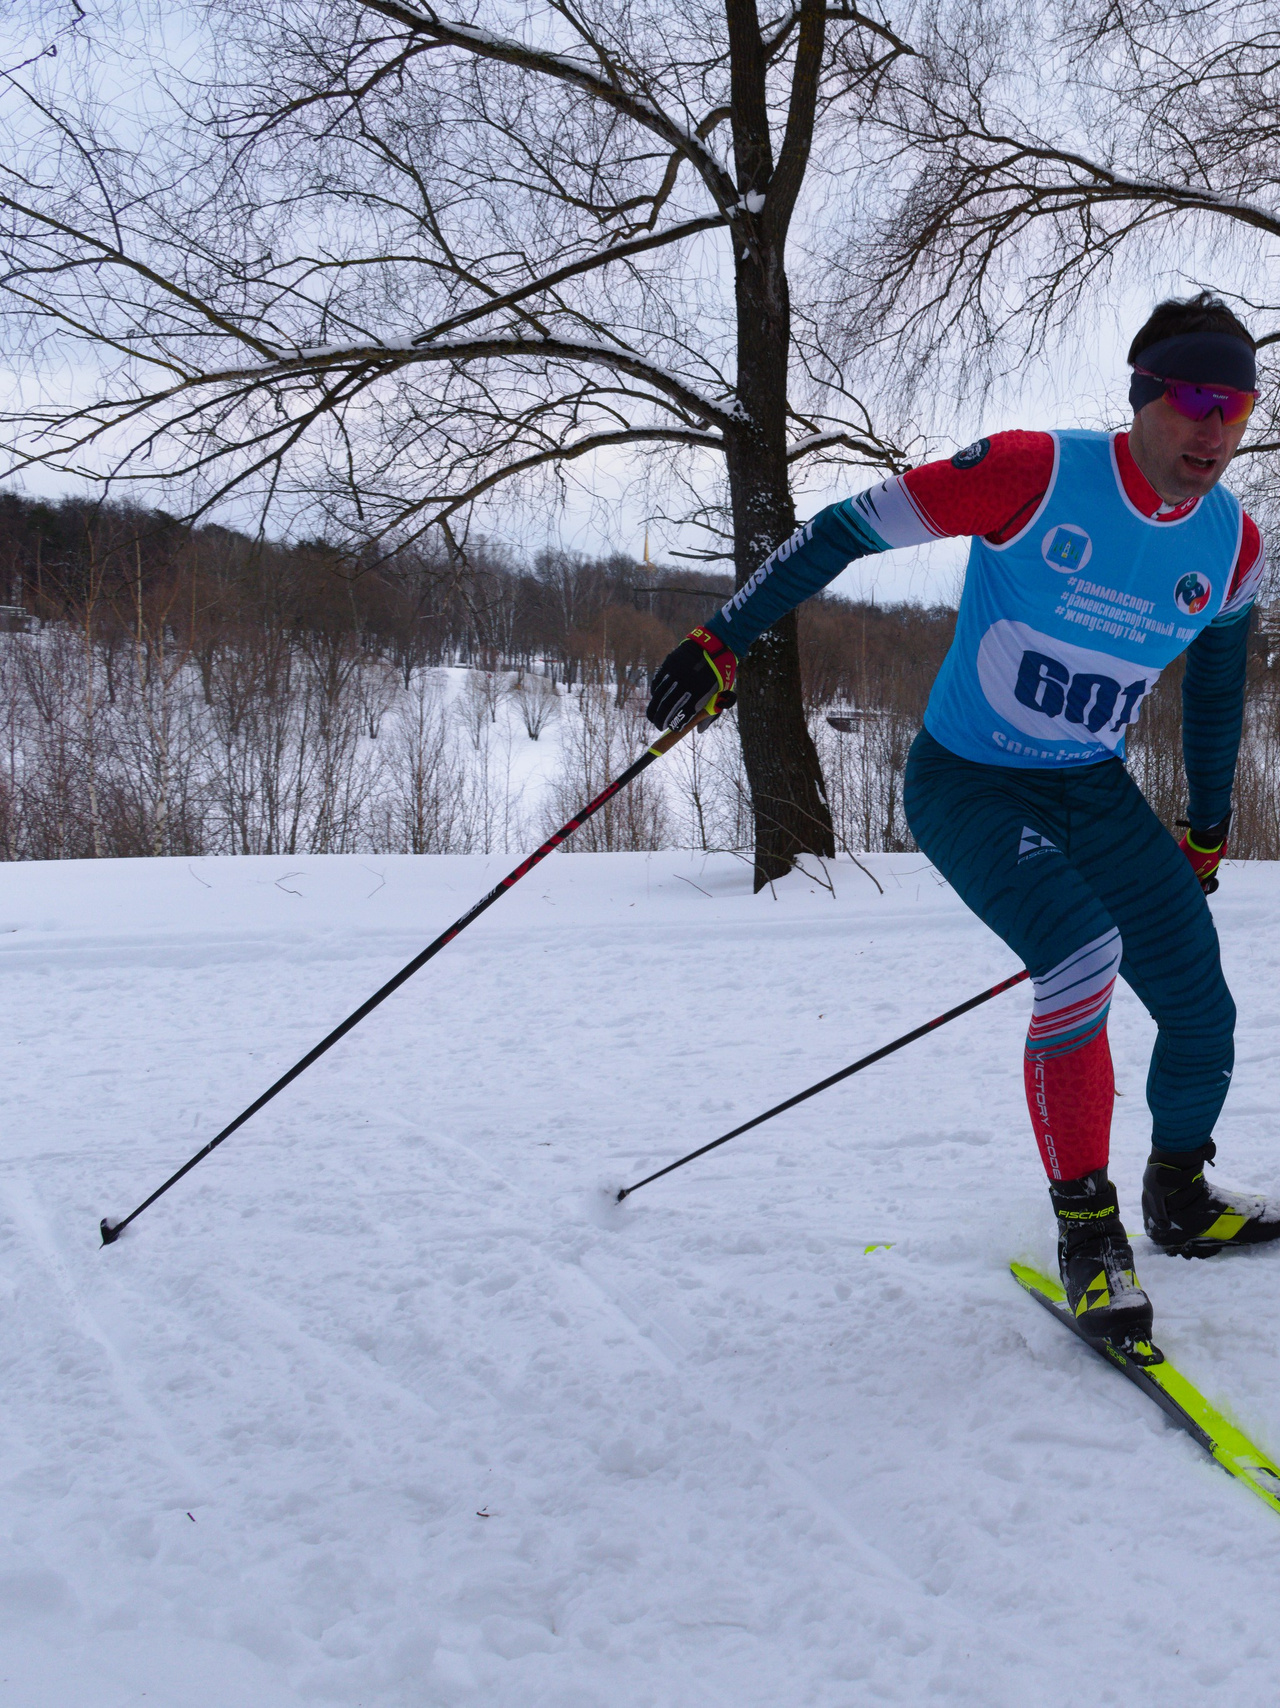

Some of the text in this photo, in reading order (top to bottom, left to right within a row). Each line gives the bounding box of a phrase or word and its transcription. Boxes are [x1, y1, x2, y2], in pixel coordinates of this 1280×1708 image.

[721, 519, 816, 623] PROSPORT
[1067, 576, 1156, 615] #раммолспорт
[1054, 605, 1147, 644] #живуспортом
[1014, 650, 1148, 733] 601
[1035, 1051, 1062, 1180] VICTORY CODE
[1058, 1205, 1115, 1219] FISCHER
